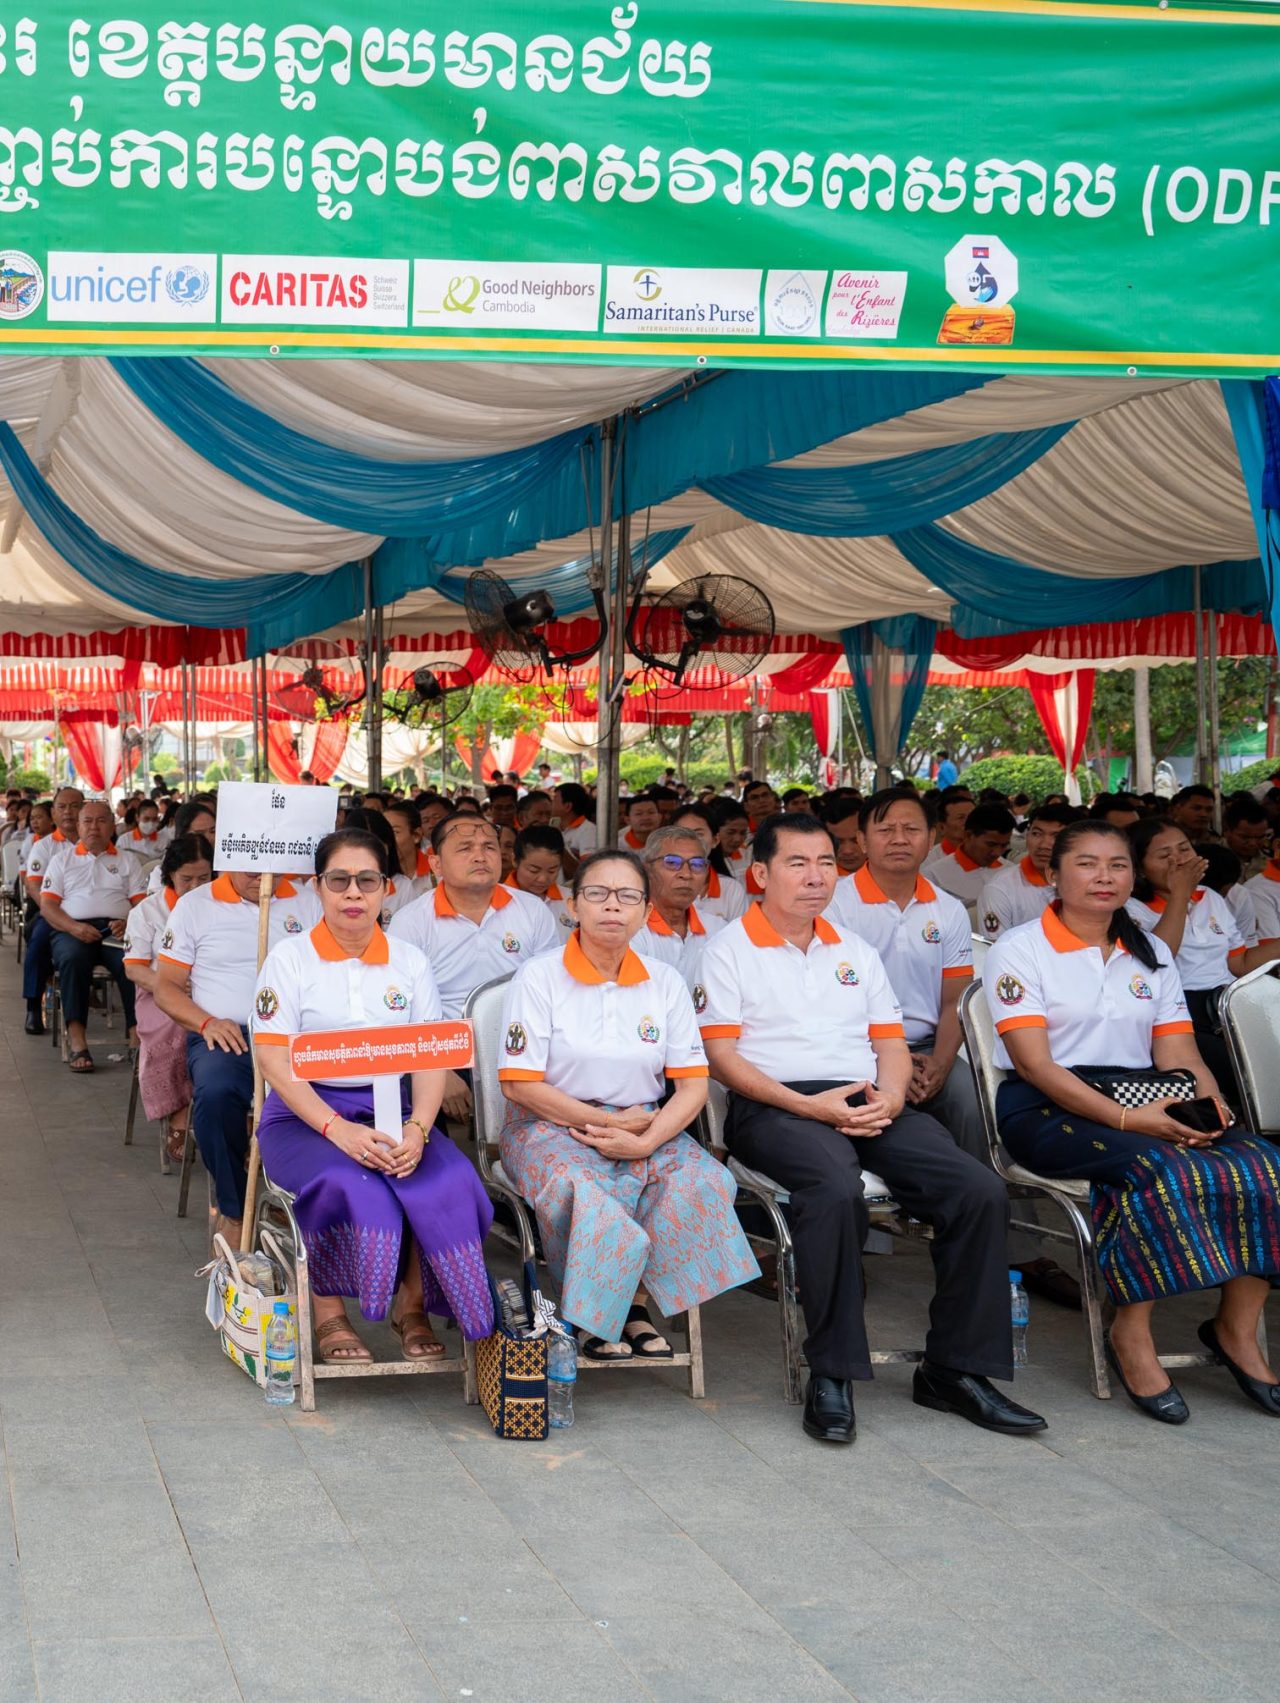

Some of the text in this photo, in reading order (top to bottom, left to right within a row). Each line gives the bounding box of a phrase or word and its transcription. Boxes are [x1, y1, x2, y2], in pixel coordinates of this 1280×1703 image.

[51, 265, 162, 303] unicef
[229, 271, 368, 309] CARITAS
[482, 279, 595, 300] Good Neighbors
[837, 272, 880, 288] Avenir
[482, 299, 536, 314] Cambodia
[606, 301, 755, 322] Samaritan's Purse
